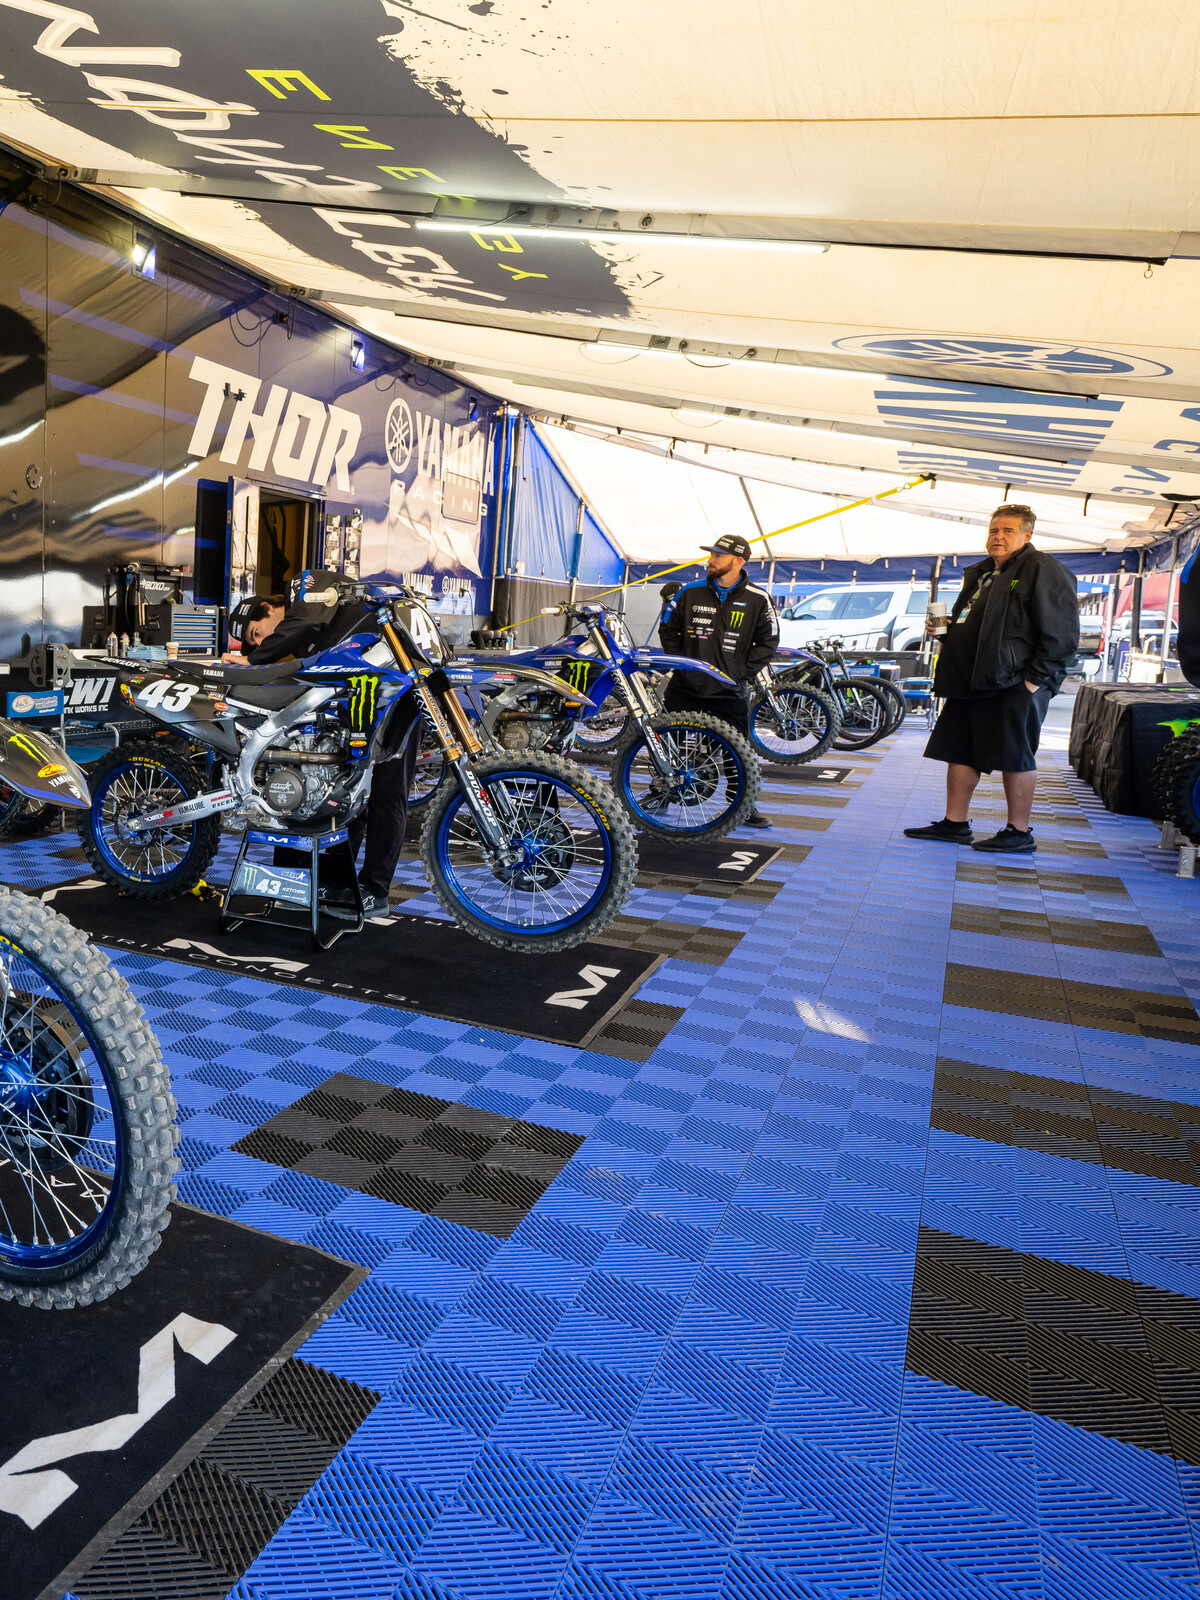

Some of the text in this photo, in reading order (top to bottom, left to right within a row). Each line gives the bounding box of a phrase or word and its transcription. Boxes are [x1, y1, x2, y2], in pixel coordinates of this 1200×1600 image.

[187, 355, 362, 493] THOR
[415, 410, 496, 497] YAMAHA
[392, 478, 488, 517] RACING
[99, 656, 141, 668] DUNLOP
[202, 669, 225, 678] YAMAHA
[137, 678, 200, 713] 43
[75, 705, 98, 714] WORKS
[670, 720, 707, 729] DUNLOP
[132, 755, 167, 769] DUNLOP
[178, 801, 205, 815] YAMALUBE
[576, 787, 611, 831] DUNLOP
[717, 850, 760, 873] M
[255, 878, 282, 896] 43
[188, 952, 408, 1002] CONCEPTS
[544, 964, 622, 1010] M
